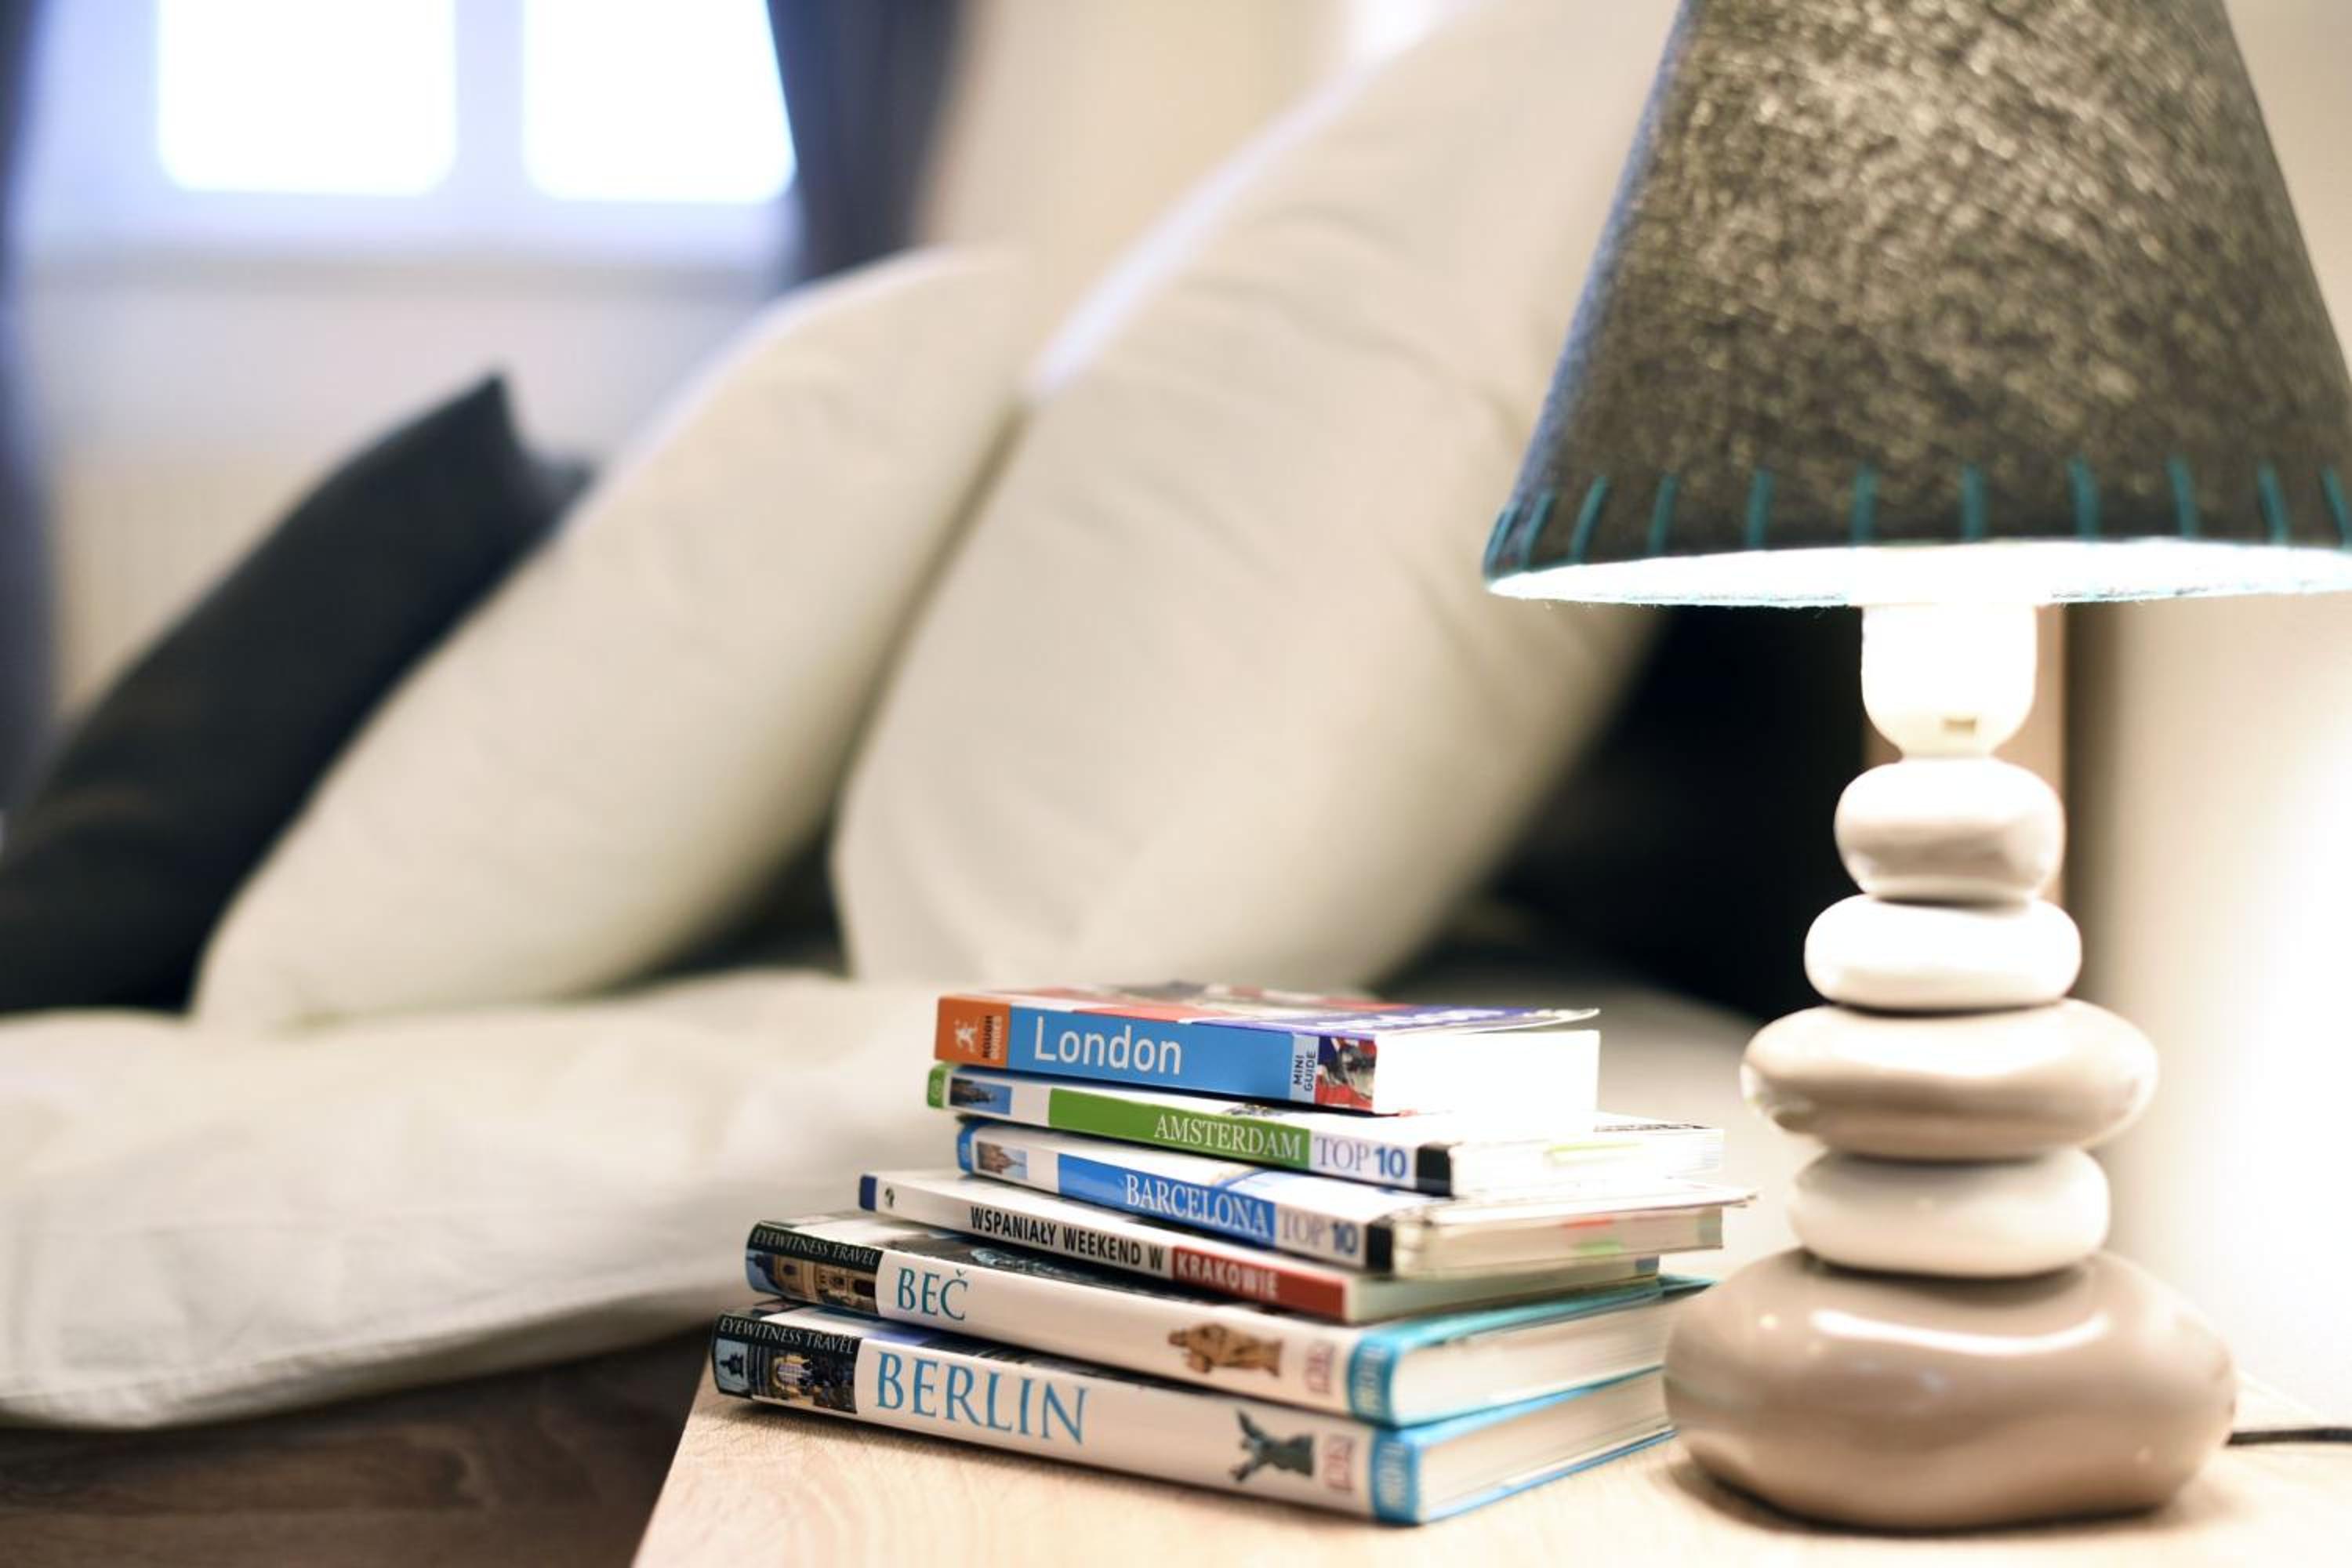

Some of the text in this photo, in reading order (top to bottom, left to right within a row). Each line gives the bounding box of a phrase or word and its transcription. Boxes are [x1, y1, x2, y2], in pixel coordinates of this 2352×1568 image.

[1034, 1015, 1182, 1075] London
[1294, 1054, 1305, 1086] MINI
[1304, 1049, 1316, 1092] GUIDE
[1153, 1114, 1406, 1179] AMSTERDAM TOP 10
[1125, 1174, 1359, 1255] BARCELONA TOP 10
[753, 1228, 879, 1267] EYEWITNESS TRAVEL
[970, 1206, 1279, 1297] WSPANIAŁY WEEKEND W KRAKOWIE
[897, 1269, 968, 1321] BEČ
[720, 1316, 855, 1355] EYEWITNESS TRAVEL
[877, 1351, 1089, 1445] BERLIN
